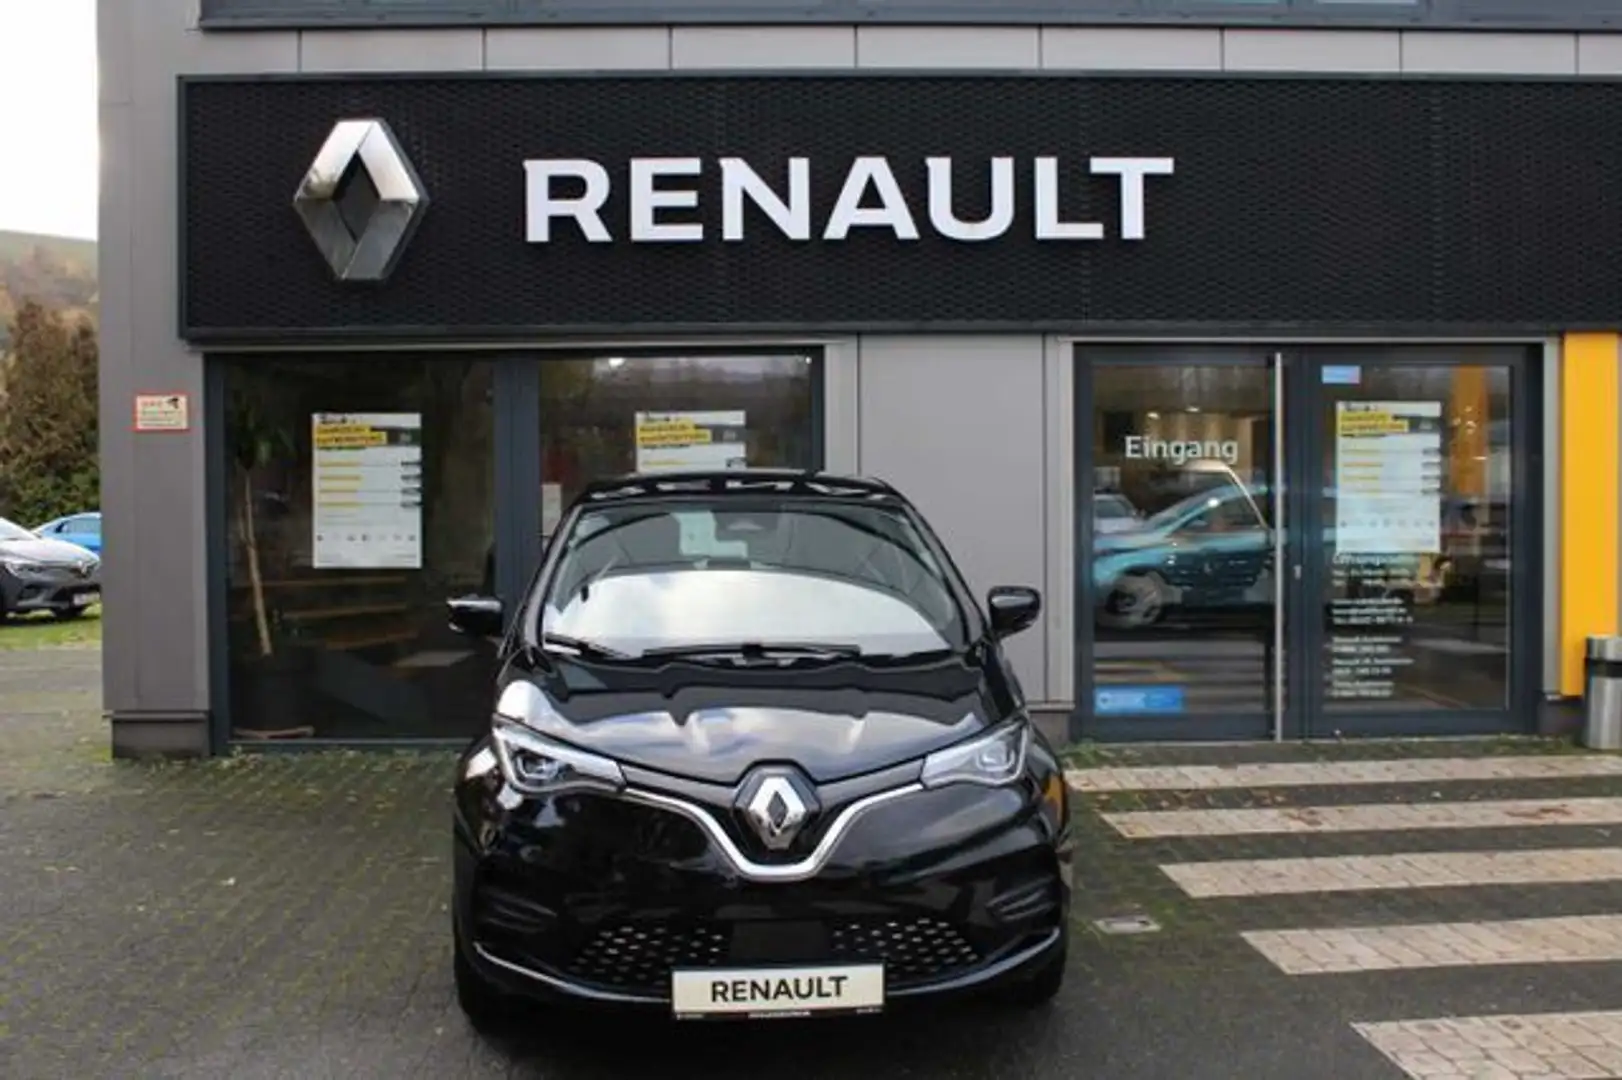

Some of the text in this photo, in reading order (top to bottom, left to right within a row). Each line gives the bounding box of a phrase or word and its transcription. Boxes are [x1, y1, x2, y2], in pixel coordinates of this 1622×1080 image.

[522, 157, 1174, 242] RENAULT
[1125, 435, 1239, 466] Eingang
[710, 976, 848, 1002] RENAULT
